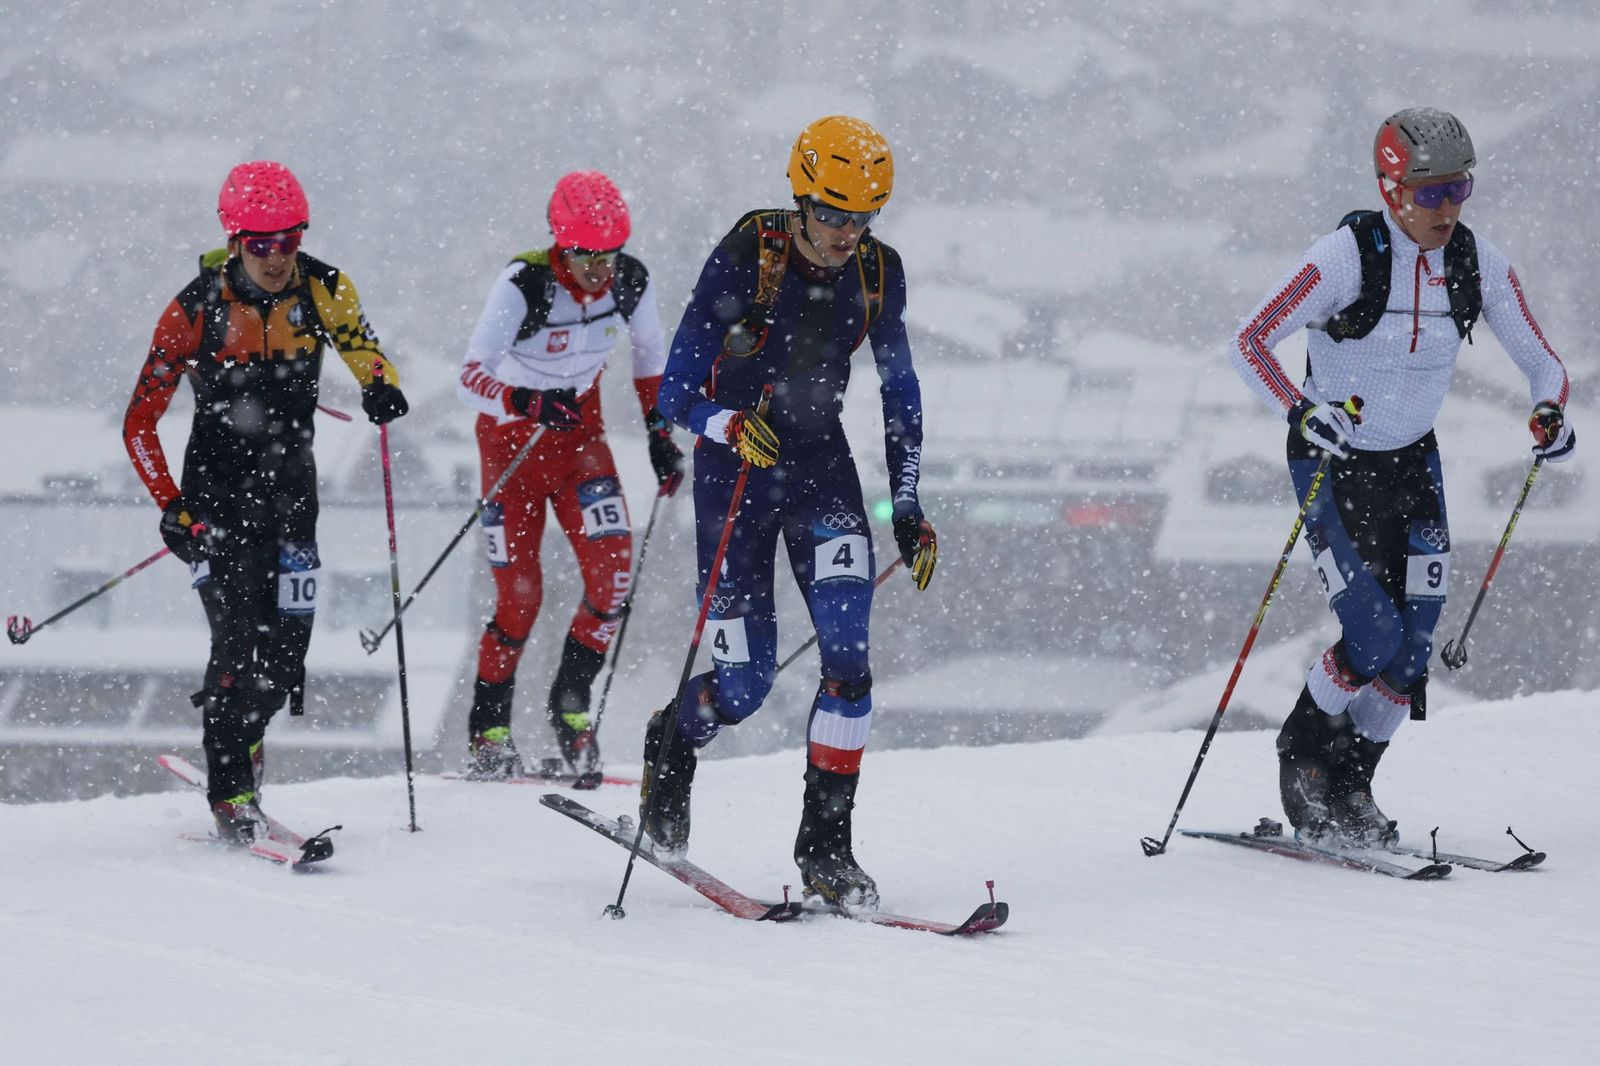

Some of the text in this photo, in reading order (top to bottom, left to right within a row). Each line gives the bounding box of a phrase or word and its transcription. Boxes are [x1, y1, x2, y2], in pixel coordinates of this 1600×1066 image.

[893, 444, 921, 502] FRANCE
[590, 504, 620, 527] 15
[488, 533, 498, 555] 5
[832, 543, 854, 569] 4
[1317, 566, 1330, 593] 9
[1427, 561, 1443, 588] 9
[290, 577, 316, 602] 10
[713, 628, 730, 655] 4
